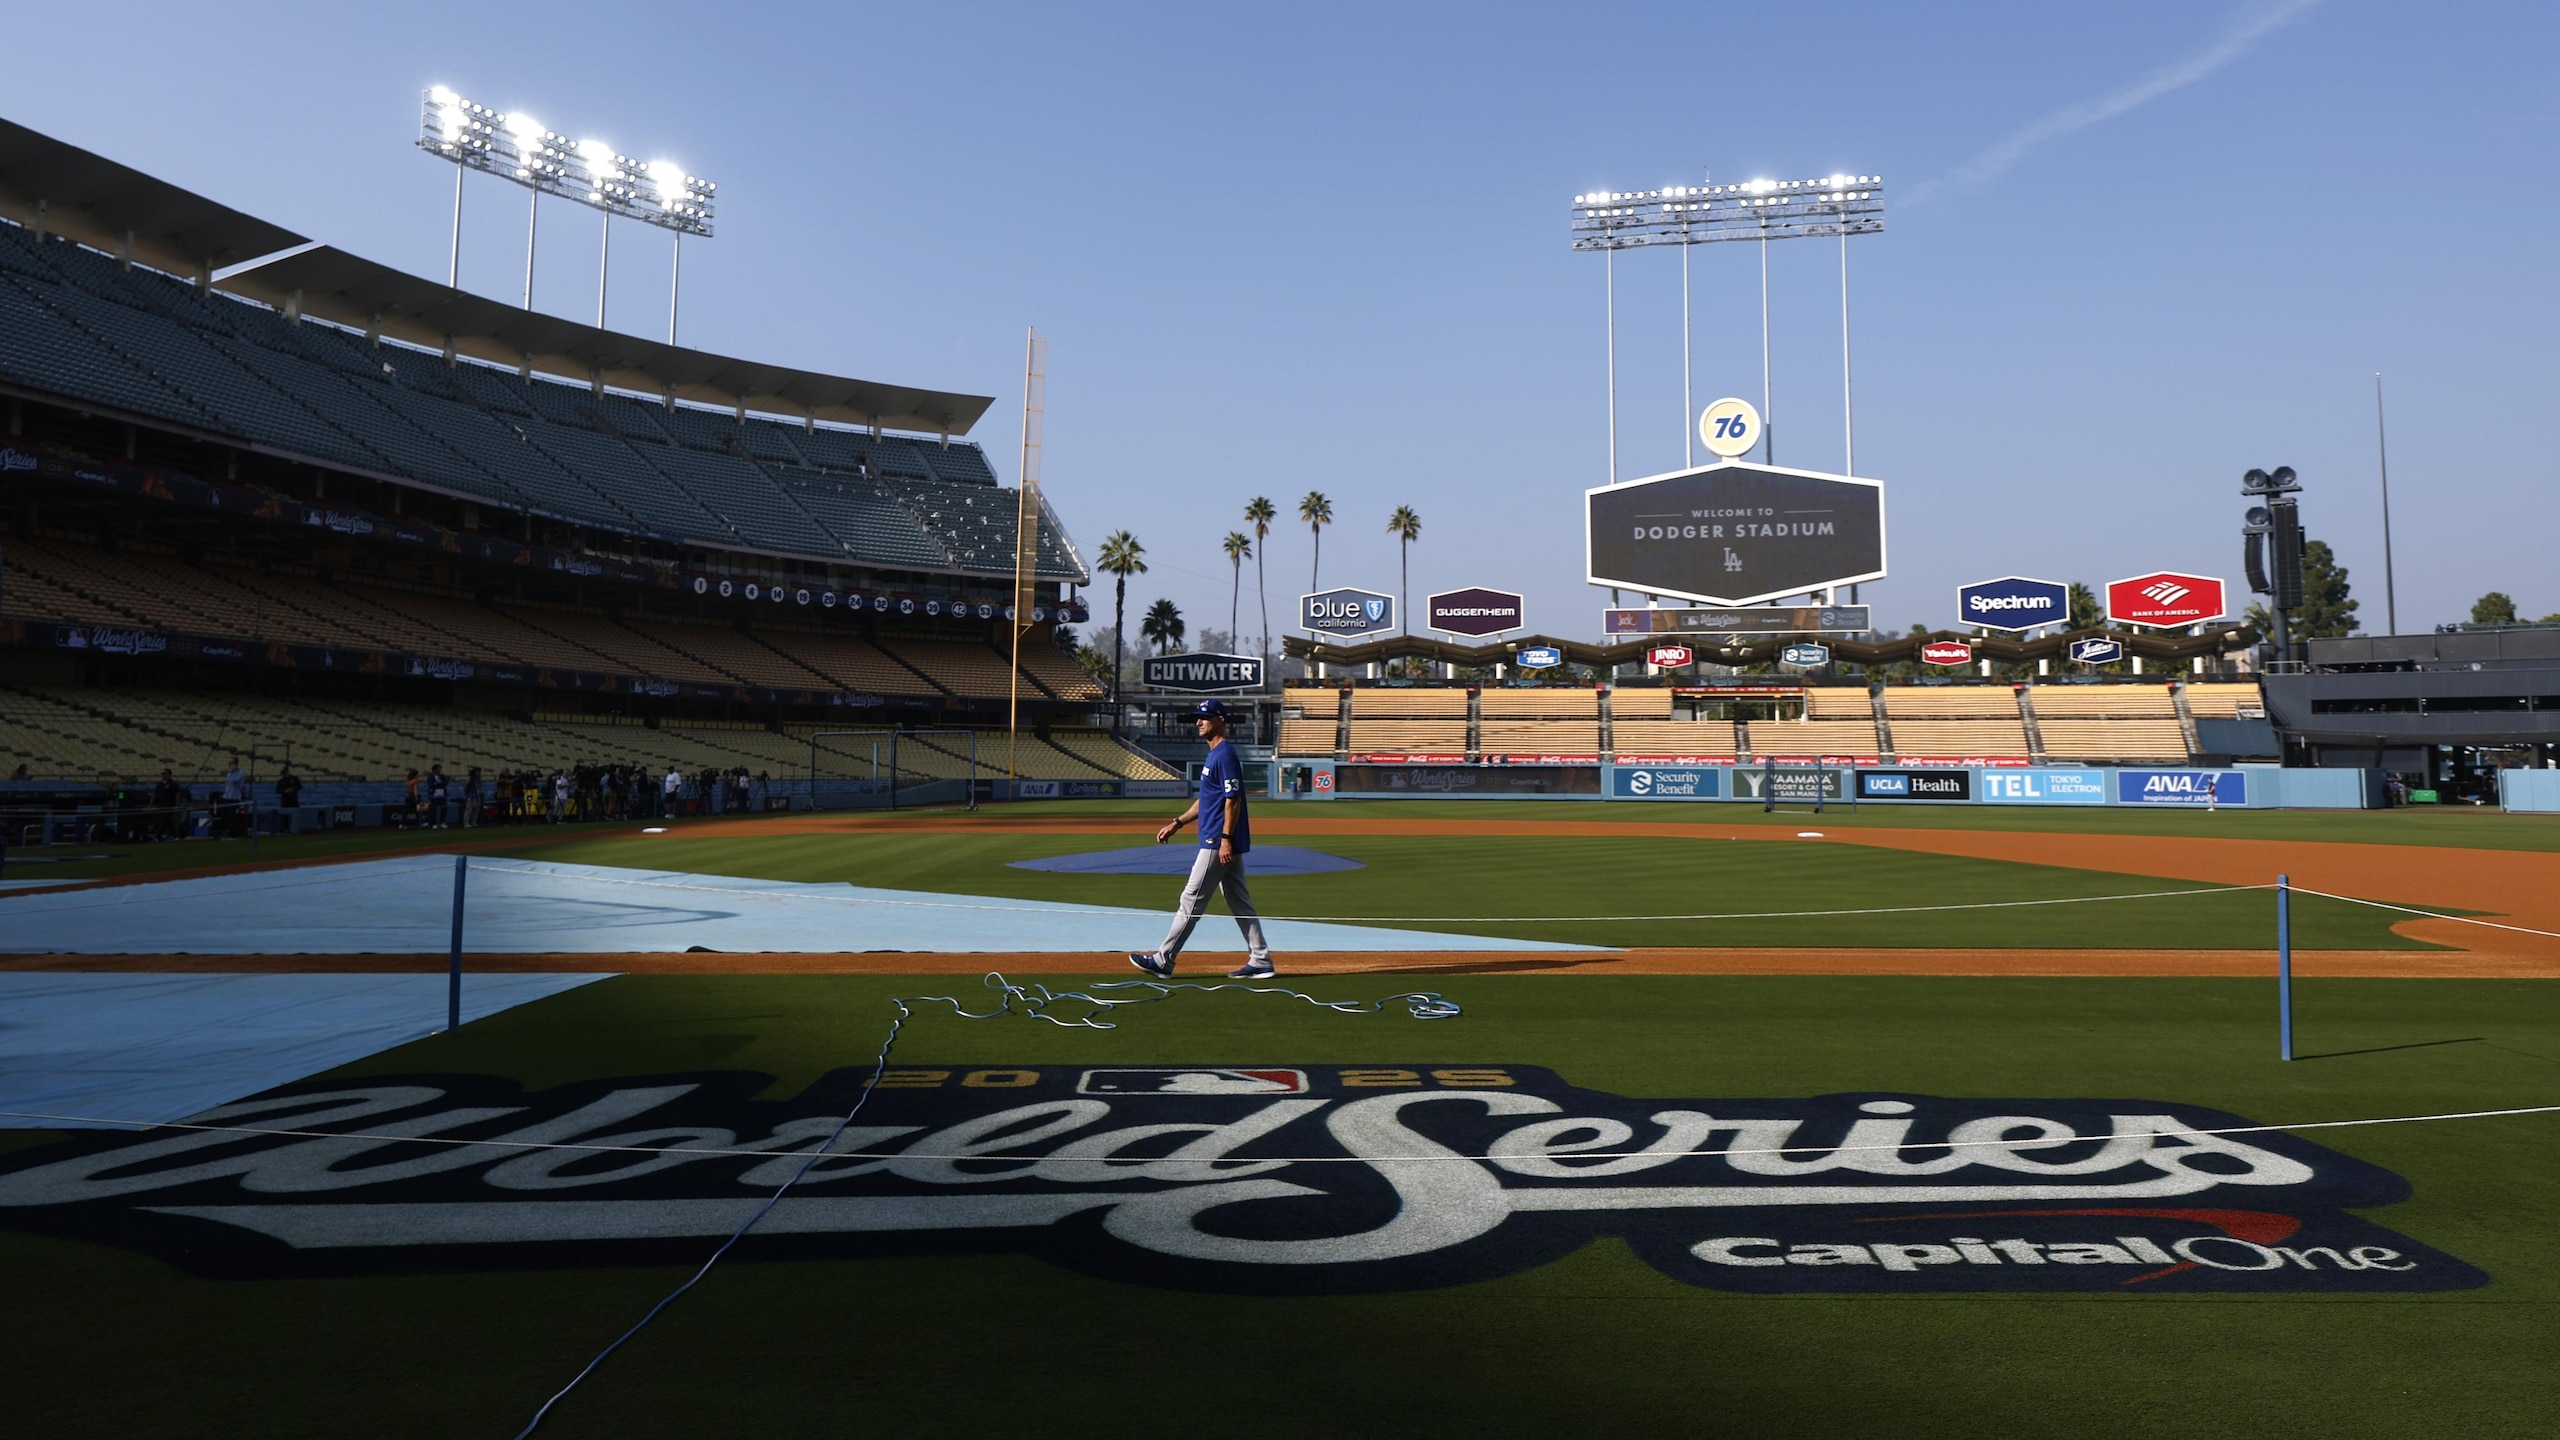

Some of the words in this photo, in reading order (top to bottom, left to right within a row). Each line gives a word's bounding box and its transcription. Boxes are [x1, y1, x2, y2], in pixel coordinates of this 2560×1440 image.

[1714, 414, 1747, 439] 76
[1691, 508, 1752, 518] WELCOME
[1758, 507, 1774, 517] TO
[1633, 525, 1724, 540] DODGER
[1735, 522, 1835, 538] STADIUM
[1310, 598, 1360, 618] blue
[1970, 595, 2051, 613] Spectrum
[1436, 608, 1515, 617] GUGGENHEIM
[1837, 609, 1865, 621] Security
[1318, 619, 1366, 628] california
[1655, 649, 1686, 662] JINRO
[1800, 649, 1823, 657] Security
[1925, 650, 1968, 658] Yakult
[1150, 662, 1254, 681] CUTWATER
[1314, 775, 1332, 789] 76
[1656, 771, 1701, 785] Security
[2050, 775, 2082, 784] TOKYO
[2143, 775, 2192, 792] ANA
[1024, 784, 1044, 795] ANA
[1224, 778, 1240, 793] 53
[1656, 783, 1695, 794] Benefit
[1870, 779, 1903, 790] UCLA
[1912, 778, 1960, 792] Health
[1986, 775, 2040, 797] TEL
[2052, 785, 2101, 793] ELECTRON
[2143, 794, 2183, 802] Inspiration
[334, 810, 355, 823] FOX
[864, 1069, 1040, 1089] 20
[1340, 1068, 1516, 1088] 25
